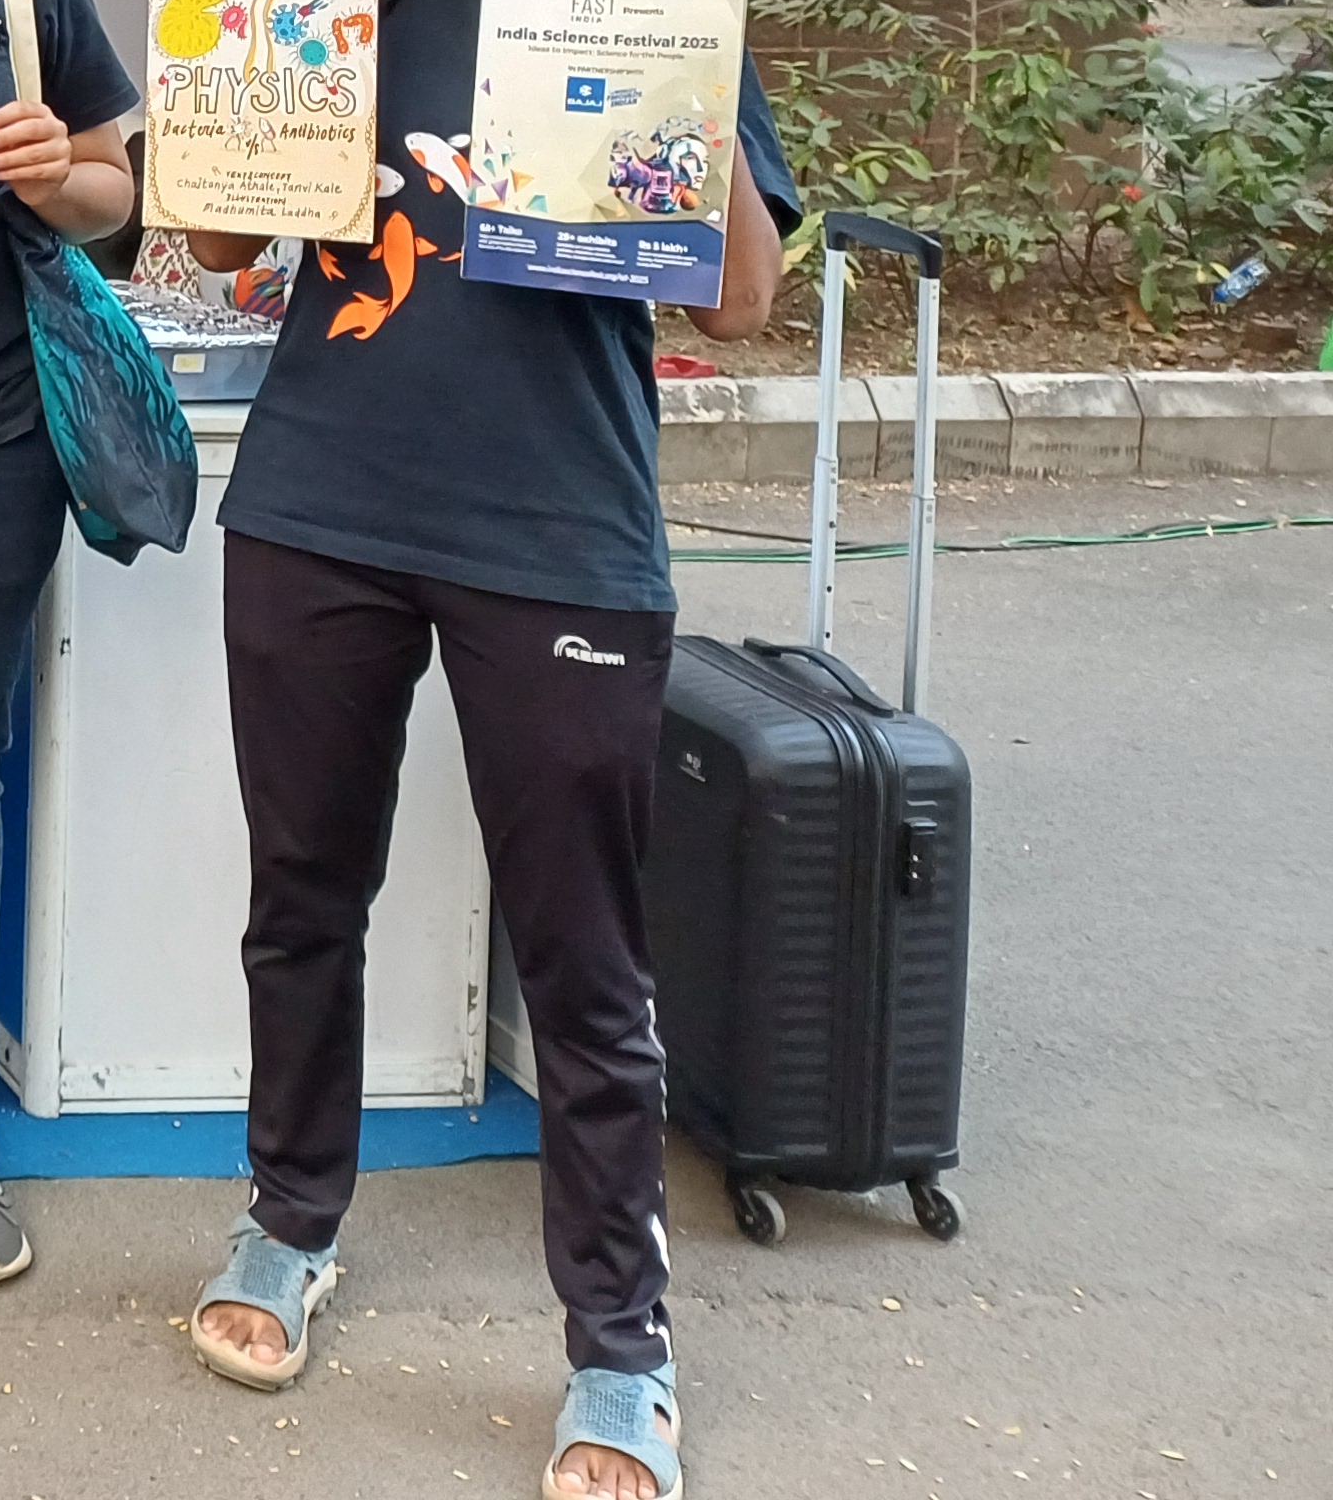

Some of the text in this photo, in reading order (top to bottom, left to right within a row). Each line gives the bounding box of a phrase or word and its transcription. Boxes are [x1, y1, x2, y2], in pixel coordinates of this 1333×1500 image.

[497, 27, 719, 49] India Science Festival 2025
[164, 64, 357, 118] PHYSICS
[567, 98, 602, 107] BAJAJ
[162, 118, 226, 138] Bacteria
[279, 123, 356, 142] Antibiotics
[177, 177, 235, 193] Chaitanya
[282, 182, 312, 193] Tanvi
[314, 183, 343, 194] Kale
[203, 203, 321, 219] Madhumita Laddha
